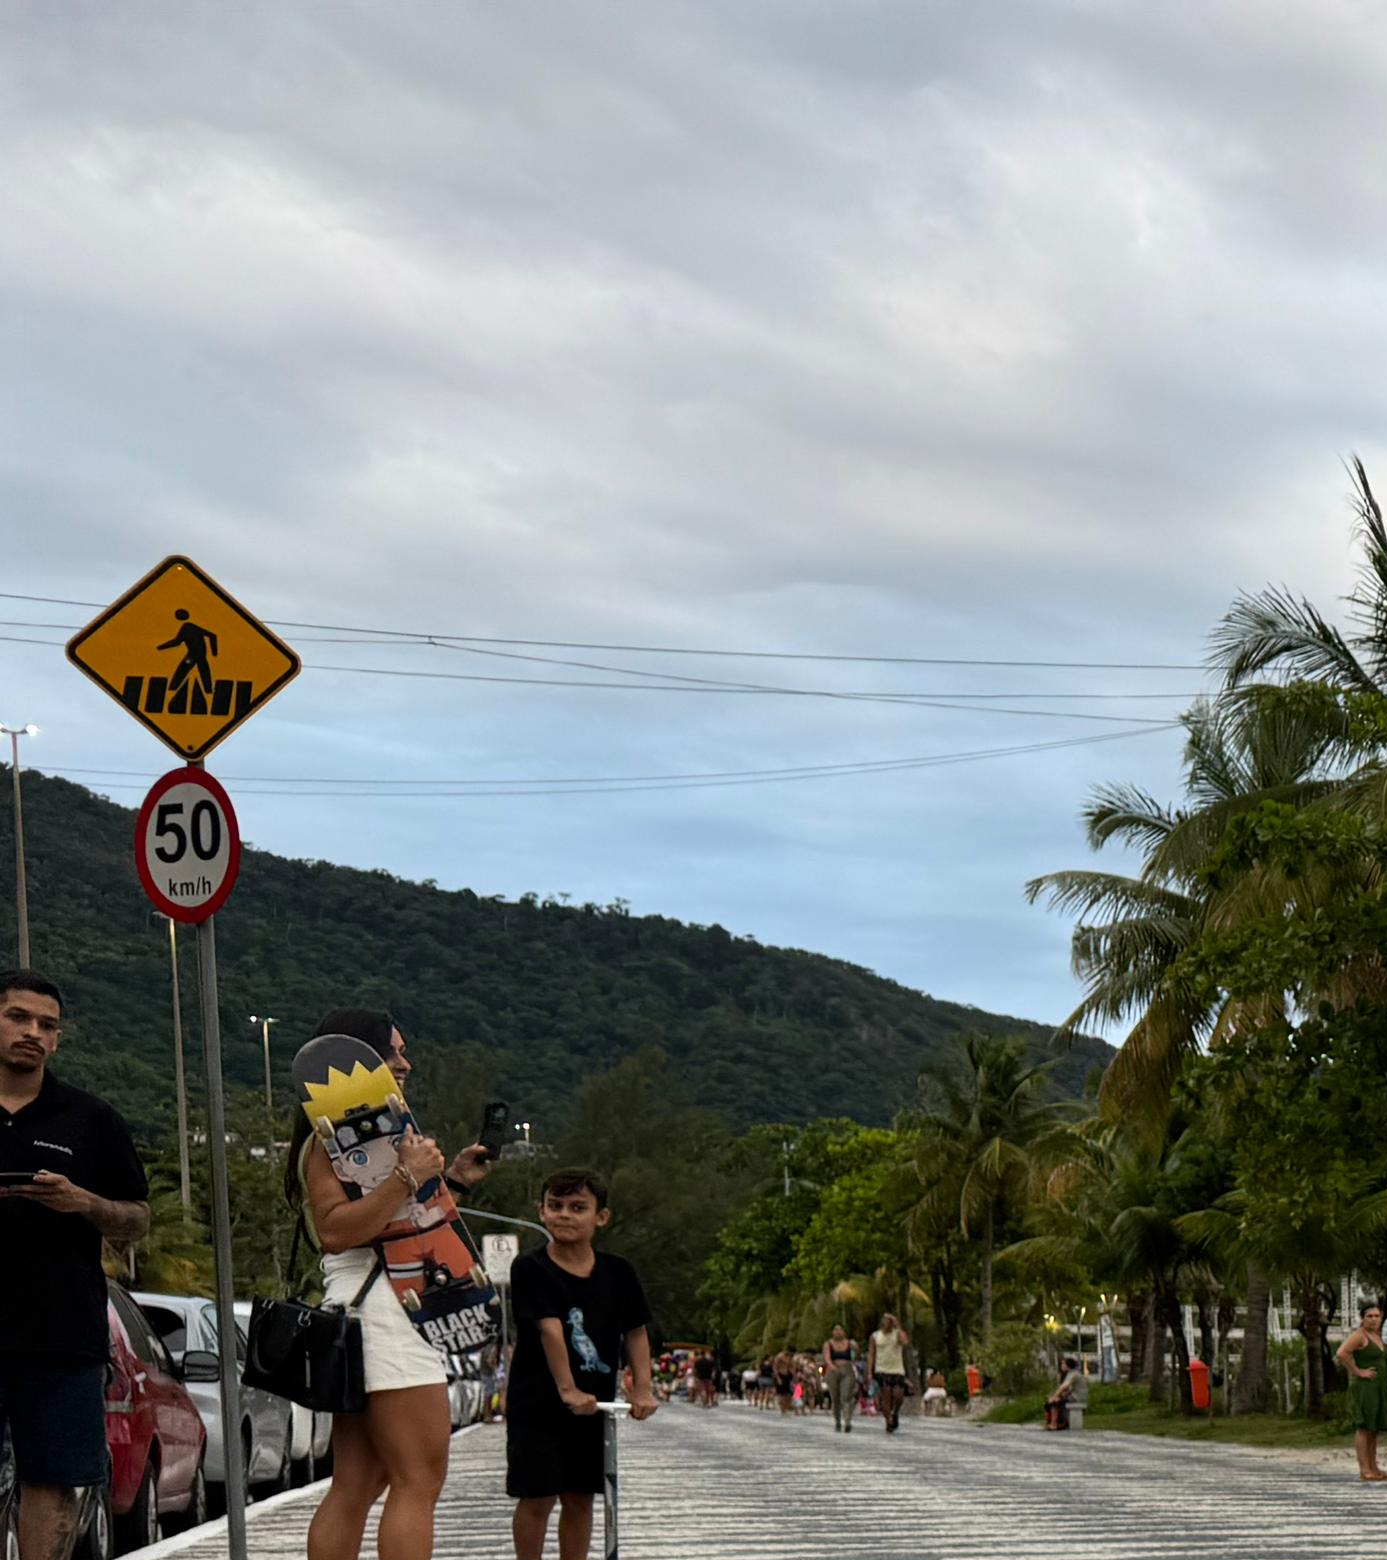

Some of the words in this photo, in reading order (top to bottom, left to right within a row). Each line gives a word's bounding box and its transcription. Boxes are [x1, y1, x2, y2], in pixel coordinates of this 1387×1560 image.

[155, 800, 221, 864] 50
[168, 876, 212, 896] km/h
[423, 1303, 492, 1341] BLACK
[431, 1325, 484, 1354] STAR
